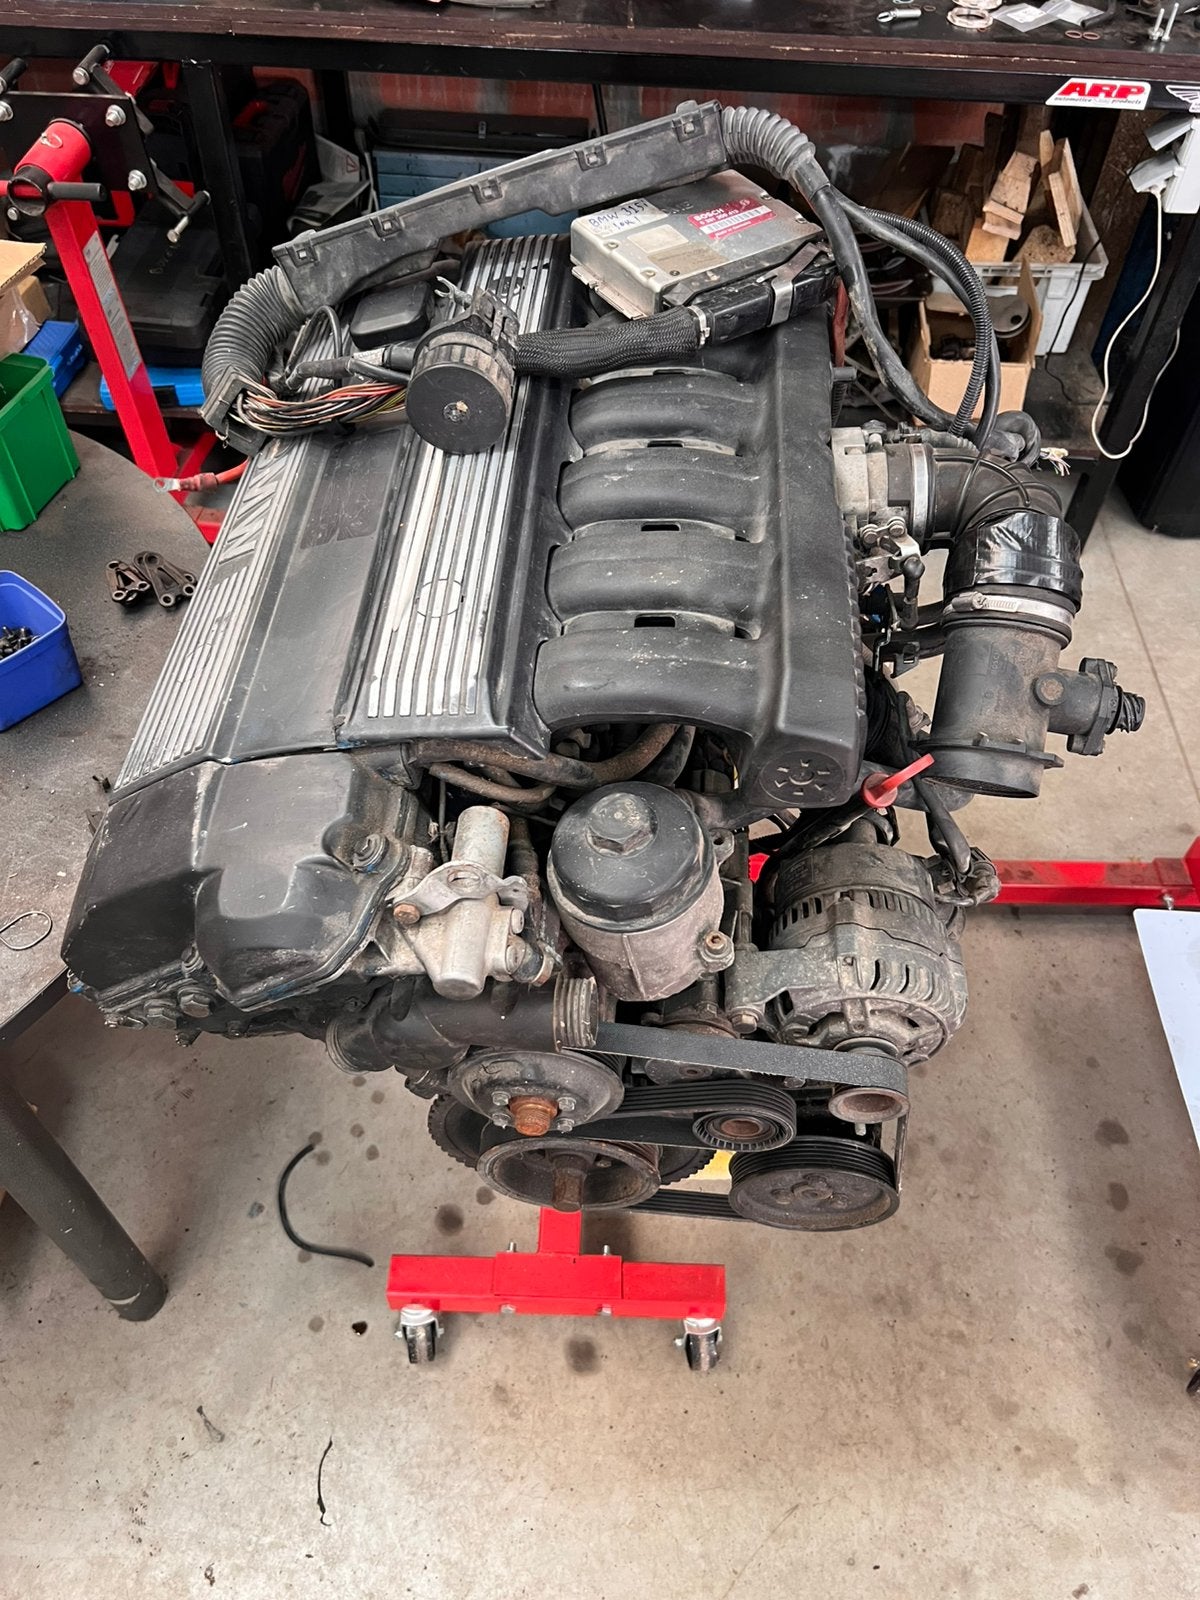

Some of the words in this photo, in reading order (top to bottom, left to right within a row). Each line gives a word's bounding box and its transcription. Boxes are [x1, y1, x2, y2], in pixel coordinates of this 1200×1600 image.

[1057, 82, 1145, 99] ARP
[588, 211, 619, 227] BMW
[693, 208, 724, 221] BOSCH
